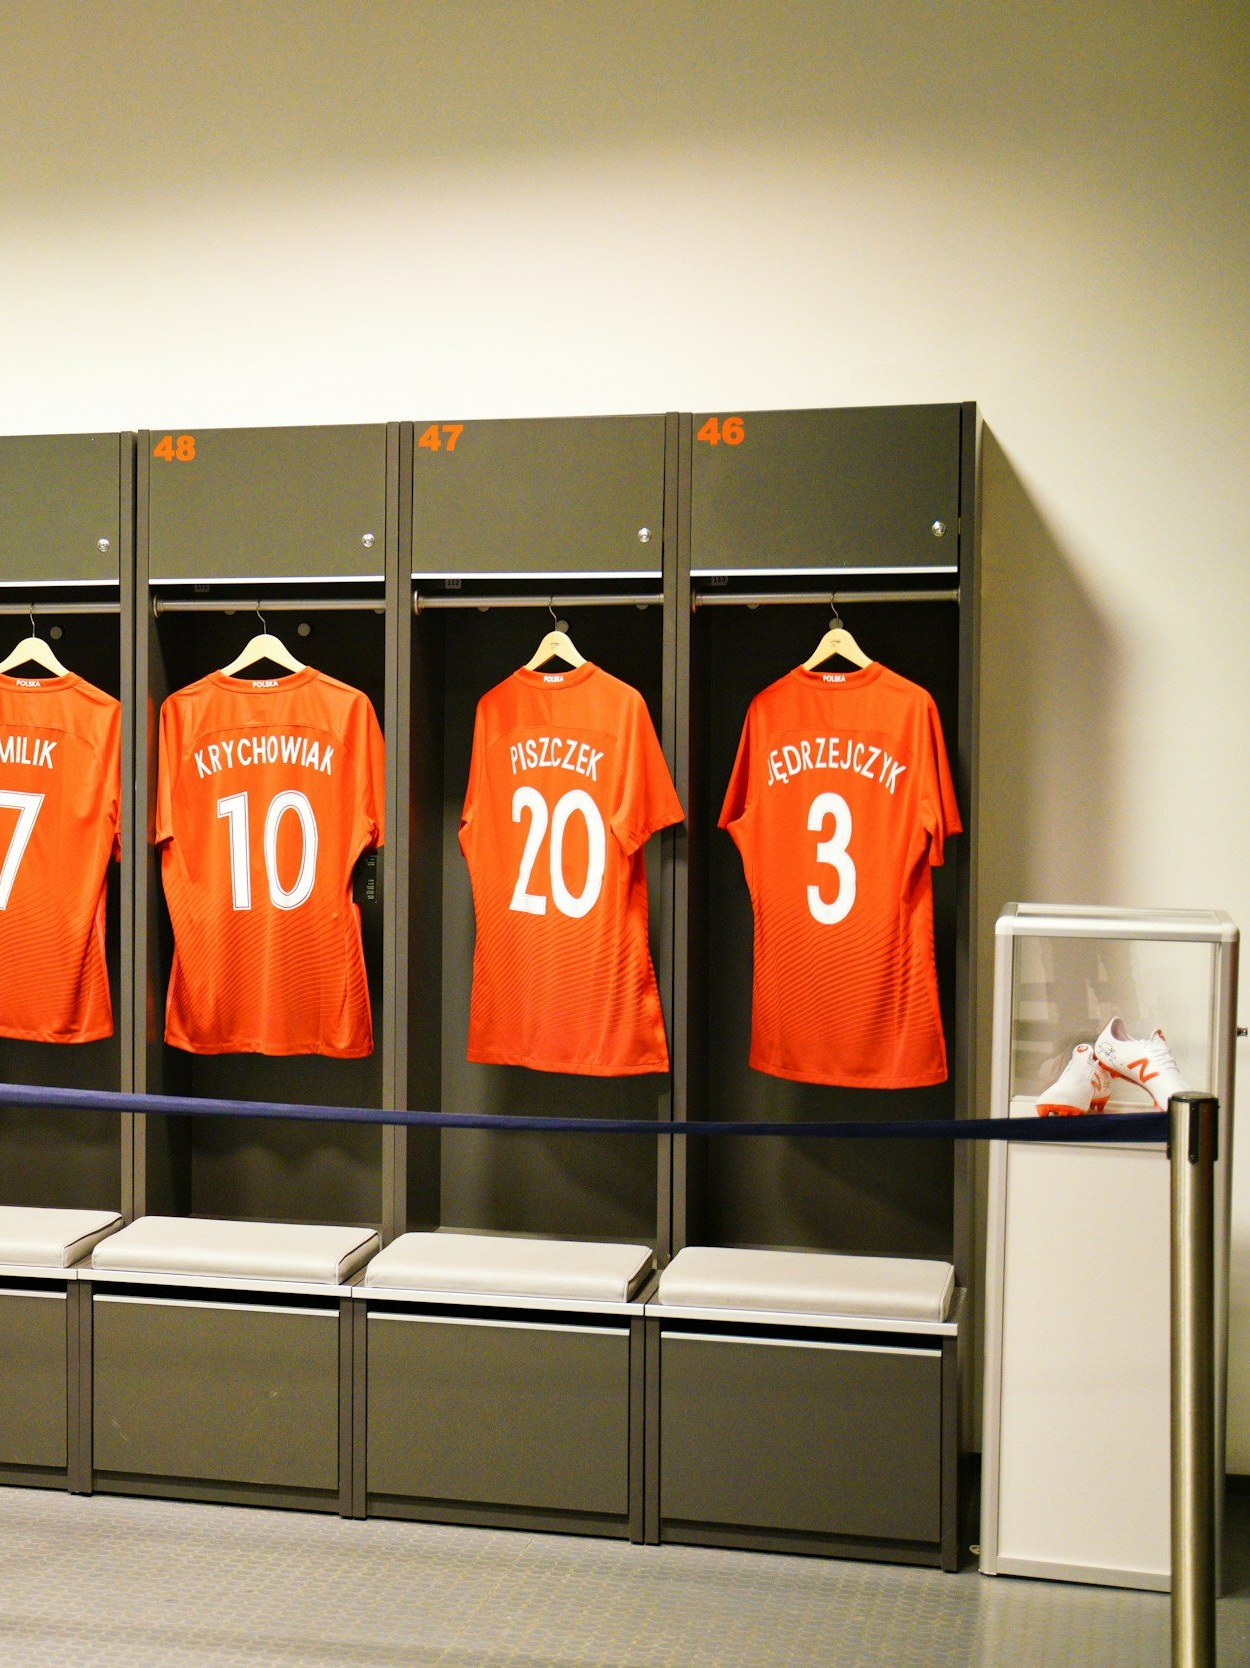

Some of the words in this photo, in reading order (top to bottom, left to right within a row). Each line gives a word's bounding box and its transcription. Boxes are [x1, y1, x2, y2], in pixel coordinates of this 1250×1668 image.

[418, 424, 465, 452] 47
[696, 416, 746, 446] 46
[153, 435, 196, 463] 48
[16, 679, 41, 688] POLSKA
[252, 680, 279, 688] POLSKA
[543, 675, 564, 683] POLSKA
[822, 675, 846, 683] POLSKA
[195, 735, 334, 778] KRYCHOWIAK
[510, 737, 604, 782] PISZCZEK
[767, 737, 907, 794] JĘDRZEJCZYK
[216, 790, 318, 910] 10
[509, 786, 606, 919] 20
[807, 792, 857, 925] 3
